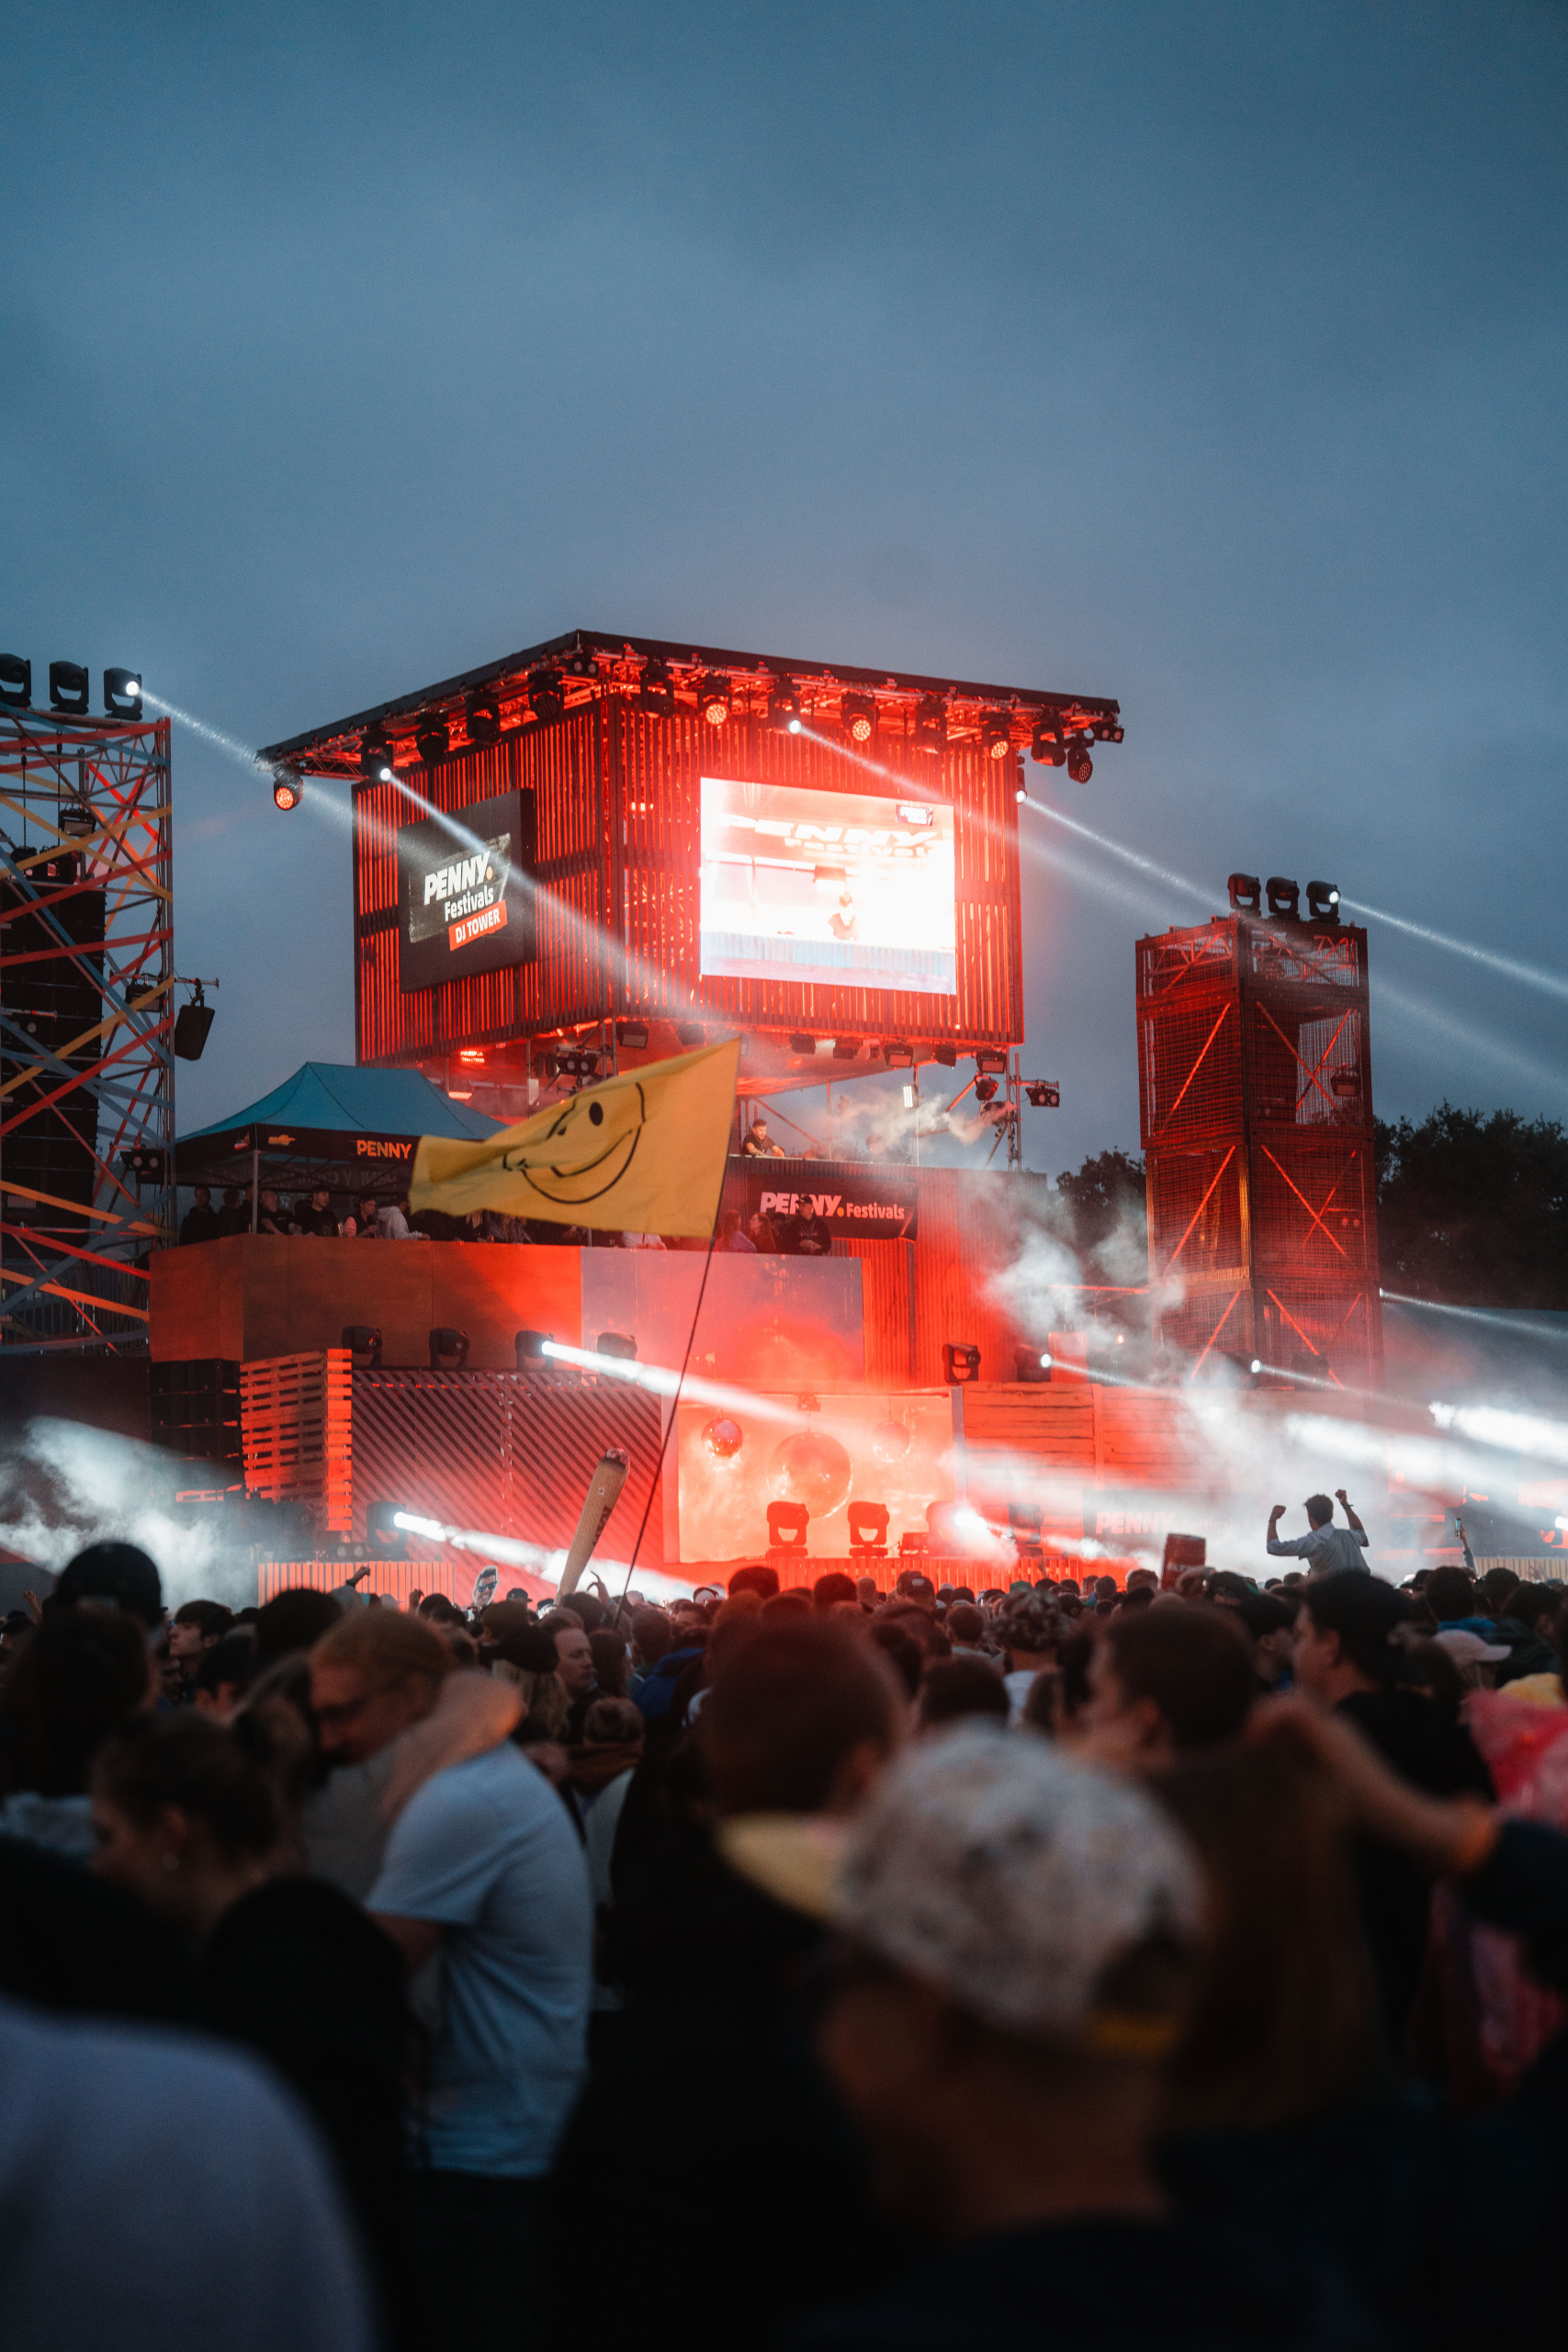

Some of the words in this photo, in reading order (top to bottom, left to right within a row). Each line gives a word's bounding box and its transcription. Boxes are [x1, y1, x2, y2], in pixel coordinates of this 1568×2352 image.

[444, 885, 494, 922] Festivals
[455, 924, 467, 944] DJ
[467, 908, 501, 937] TOWER
[356, 1139, 412, 1159] PENNY
[846, 1202, 905, 1220] Festivals
